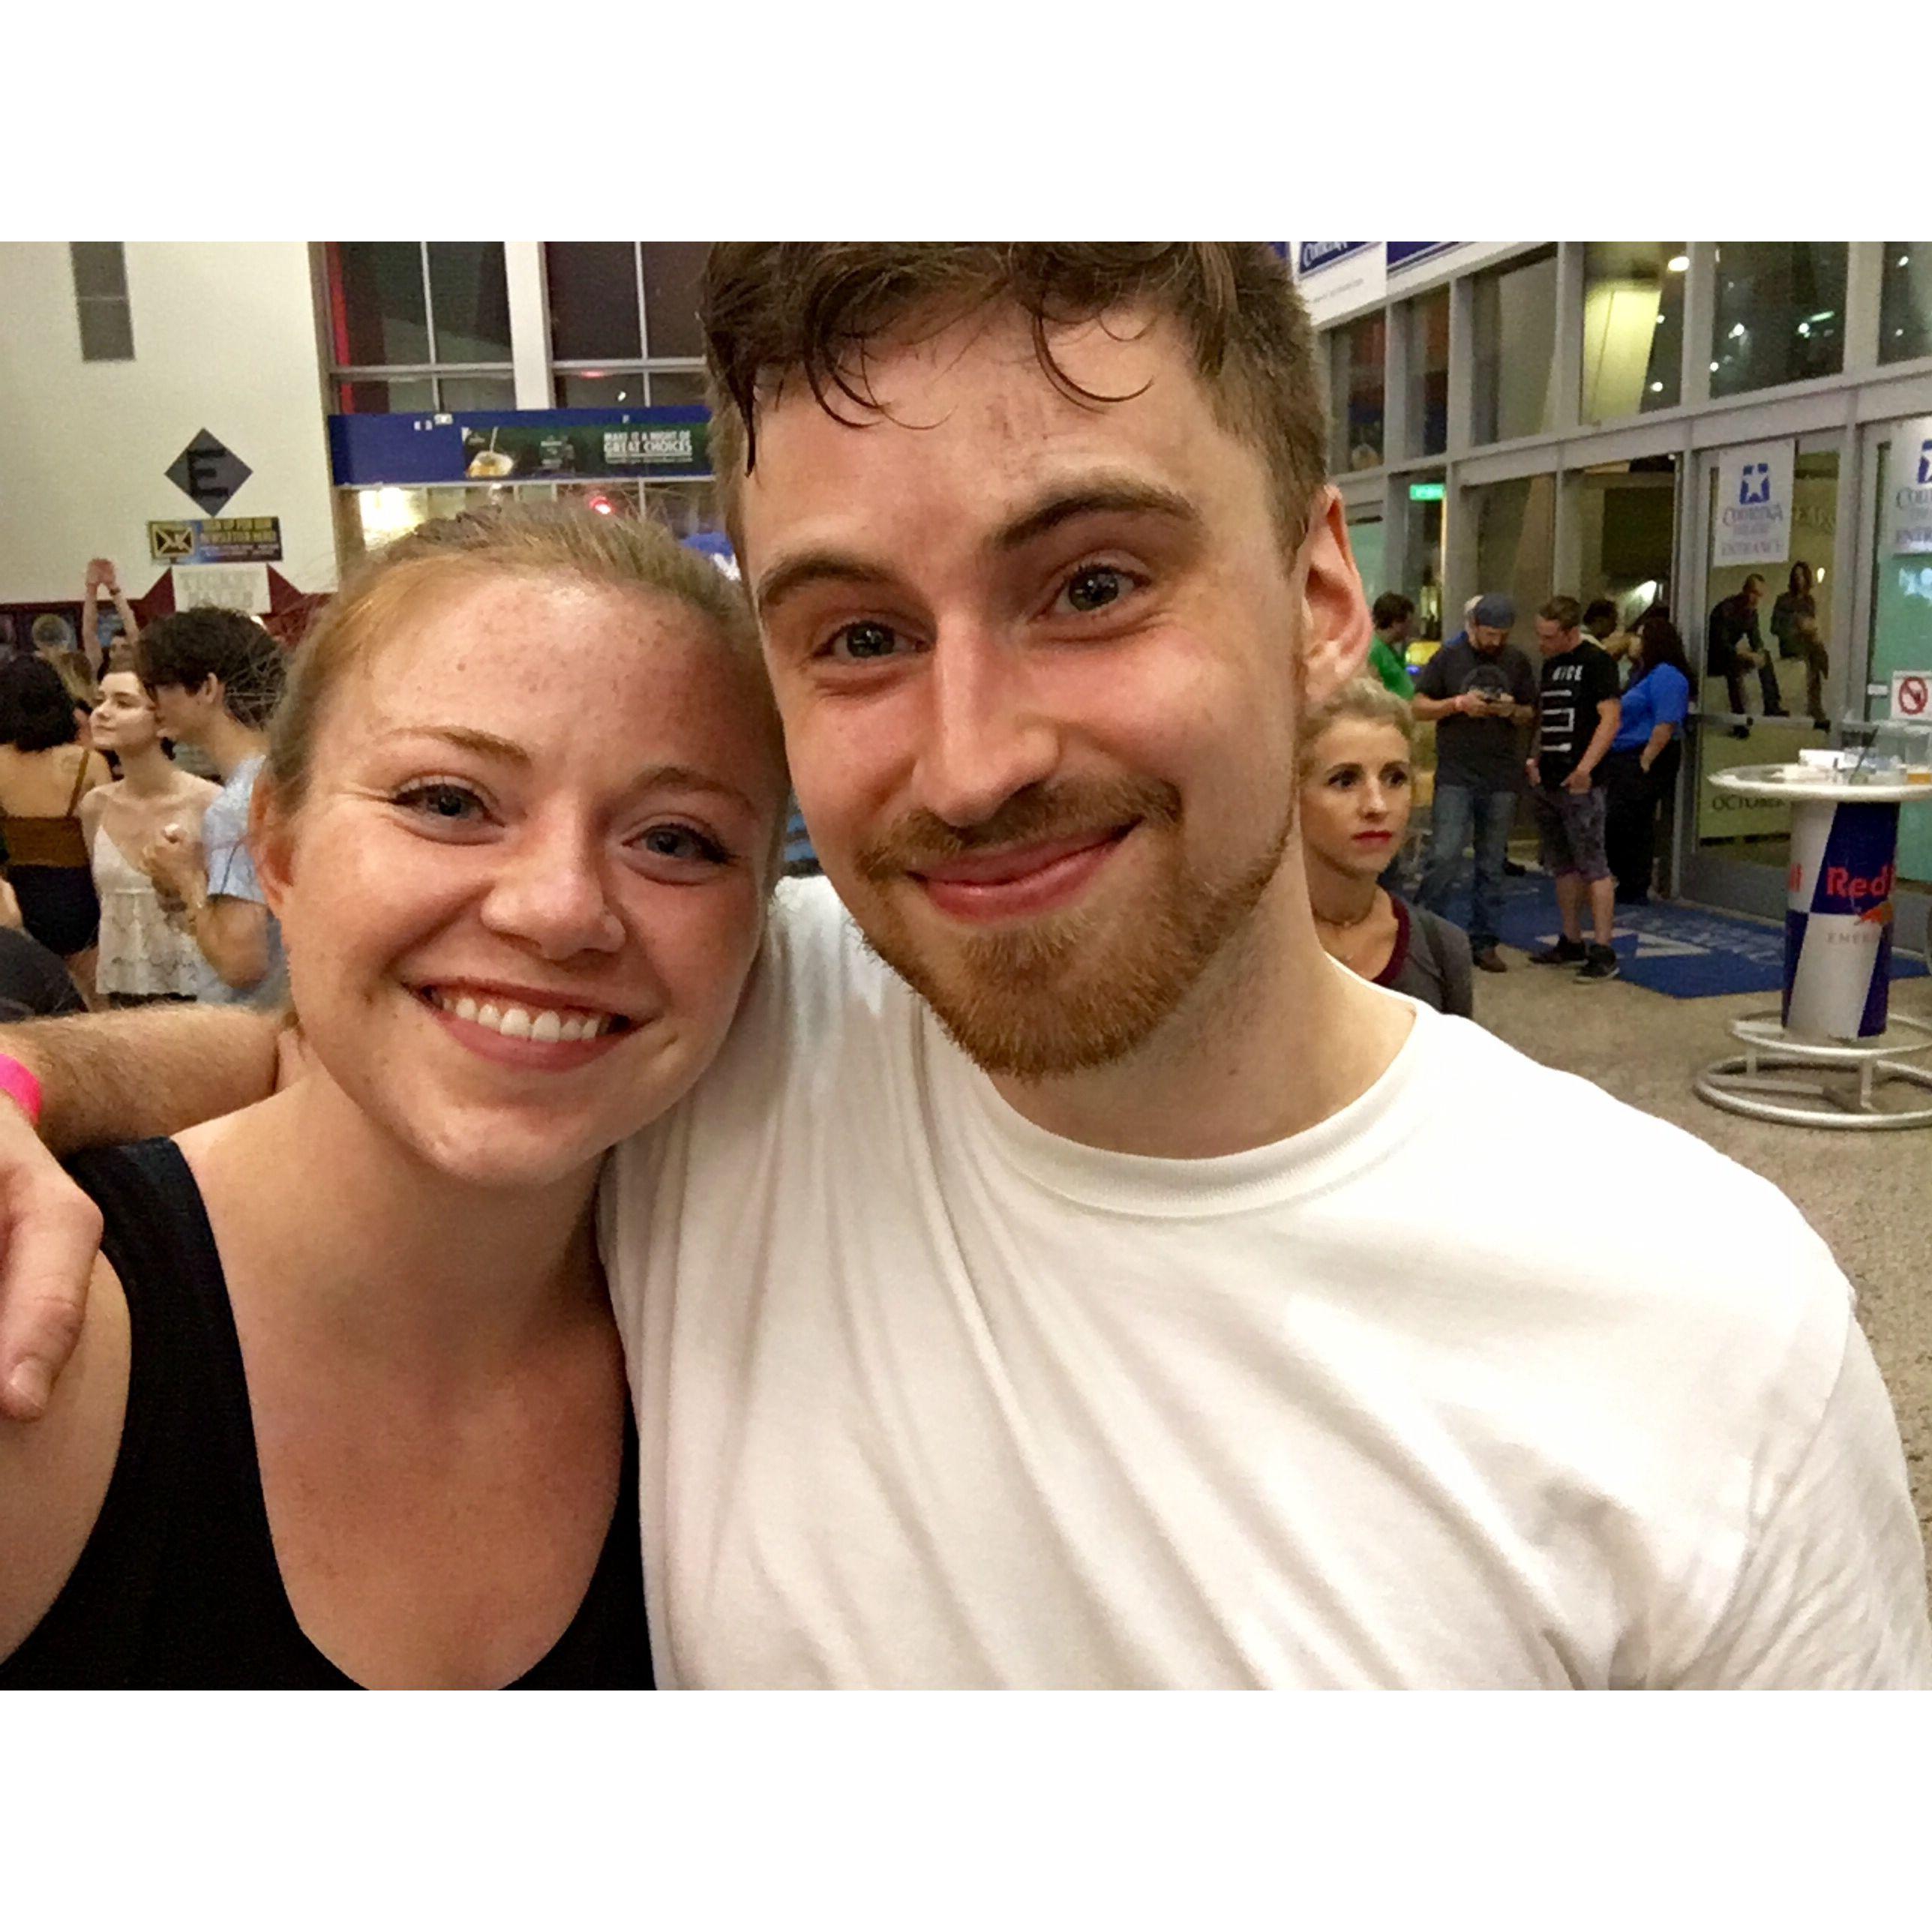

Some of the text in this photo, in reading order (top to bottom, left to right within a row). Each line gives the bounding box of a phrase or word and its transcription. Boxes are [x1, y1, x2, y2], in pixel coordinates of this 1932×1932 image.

[603, 440, 692, 453] GREAT CHOICES
[187, 449, 229, 496] E
[1826, 864, 1888, 898] Red
